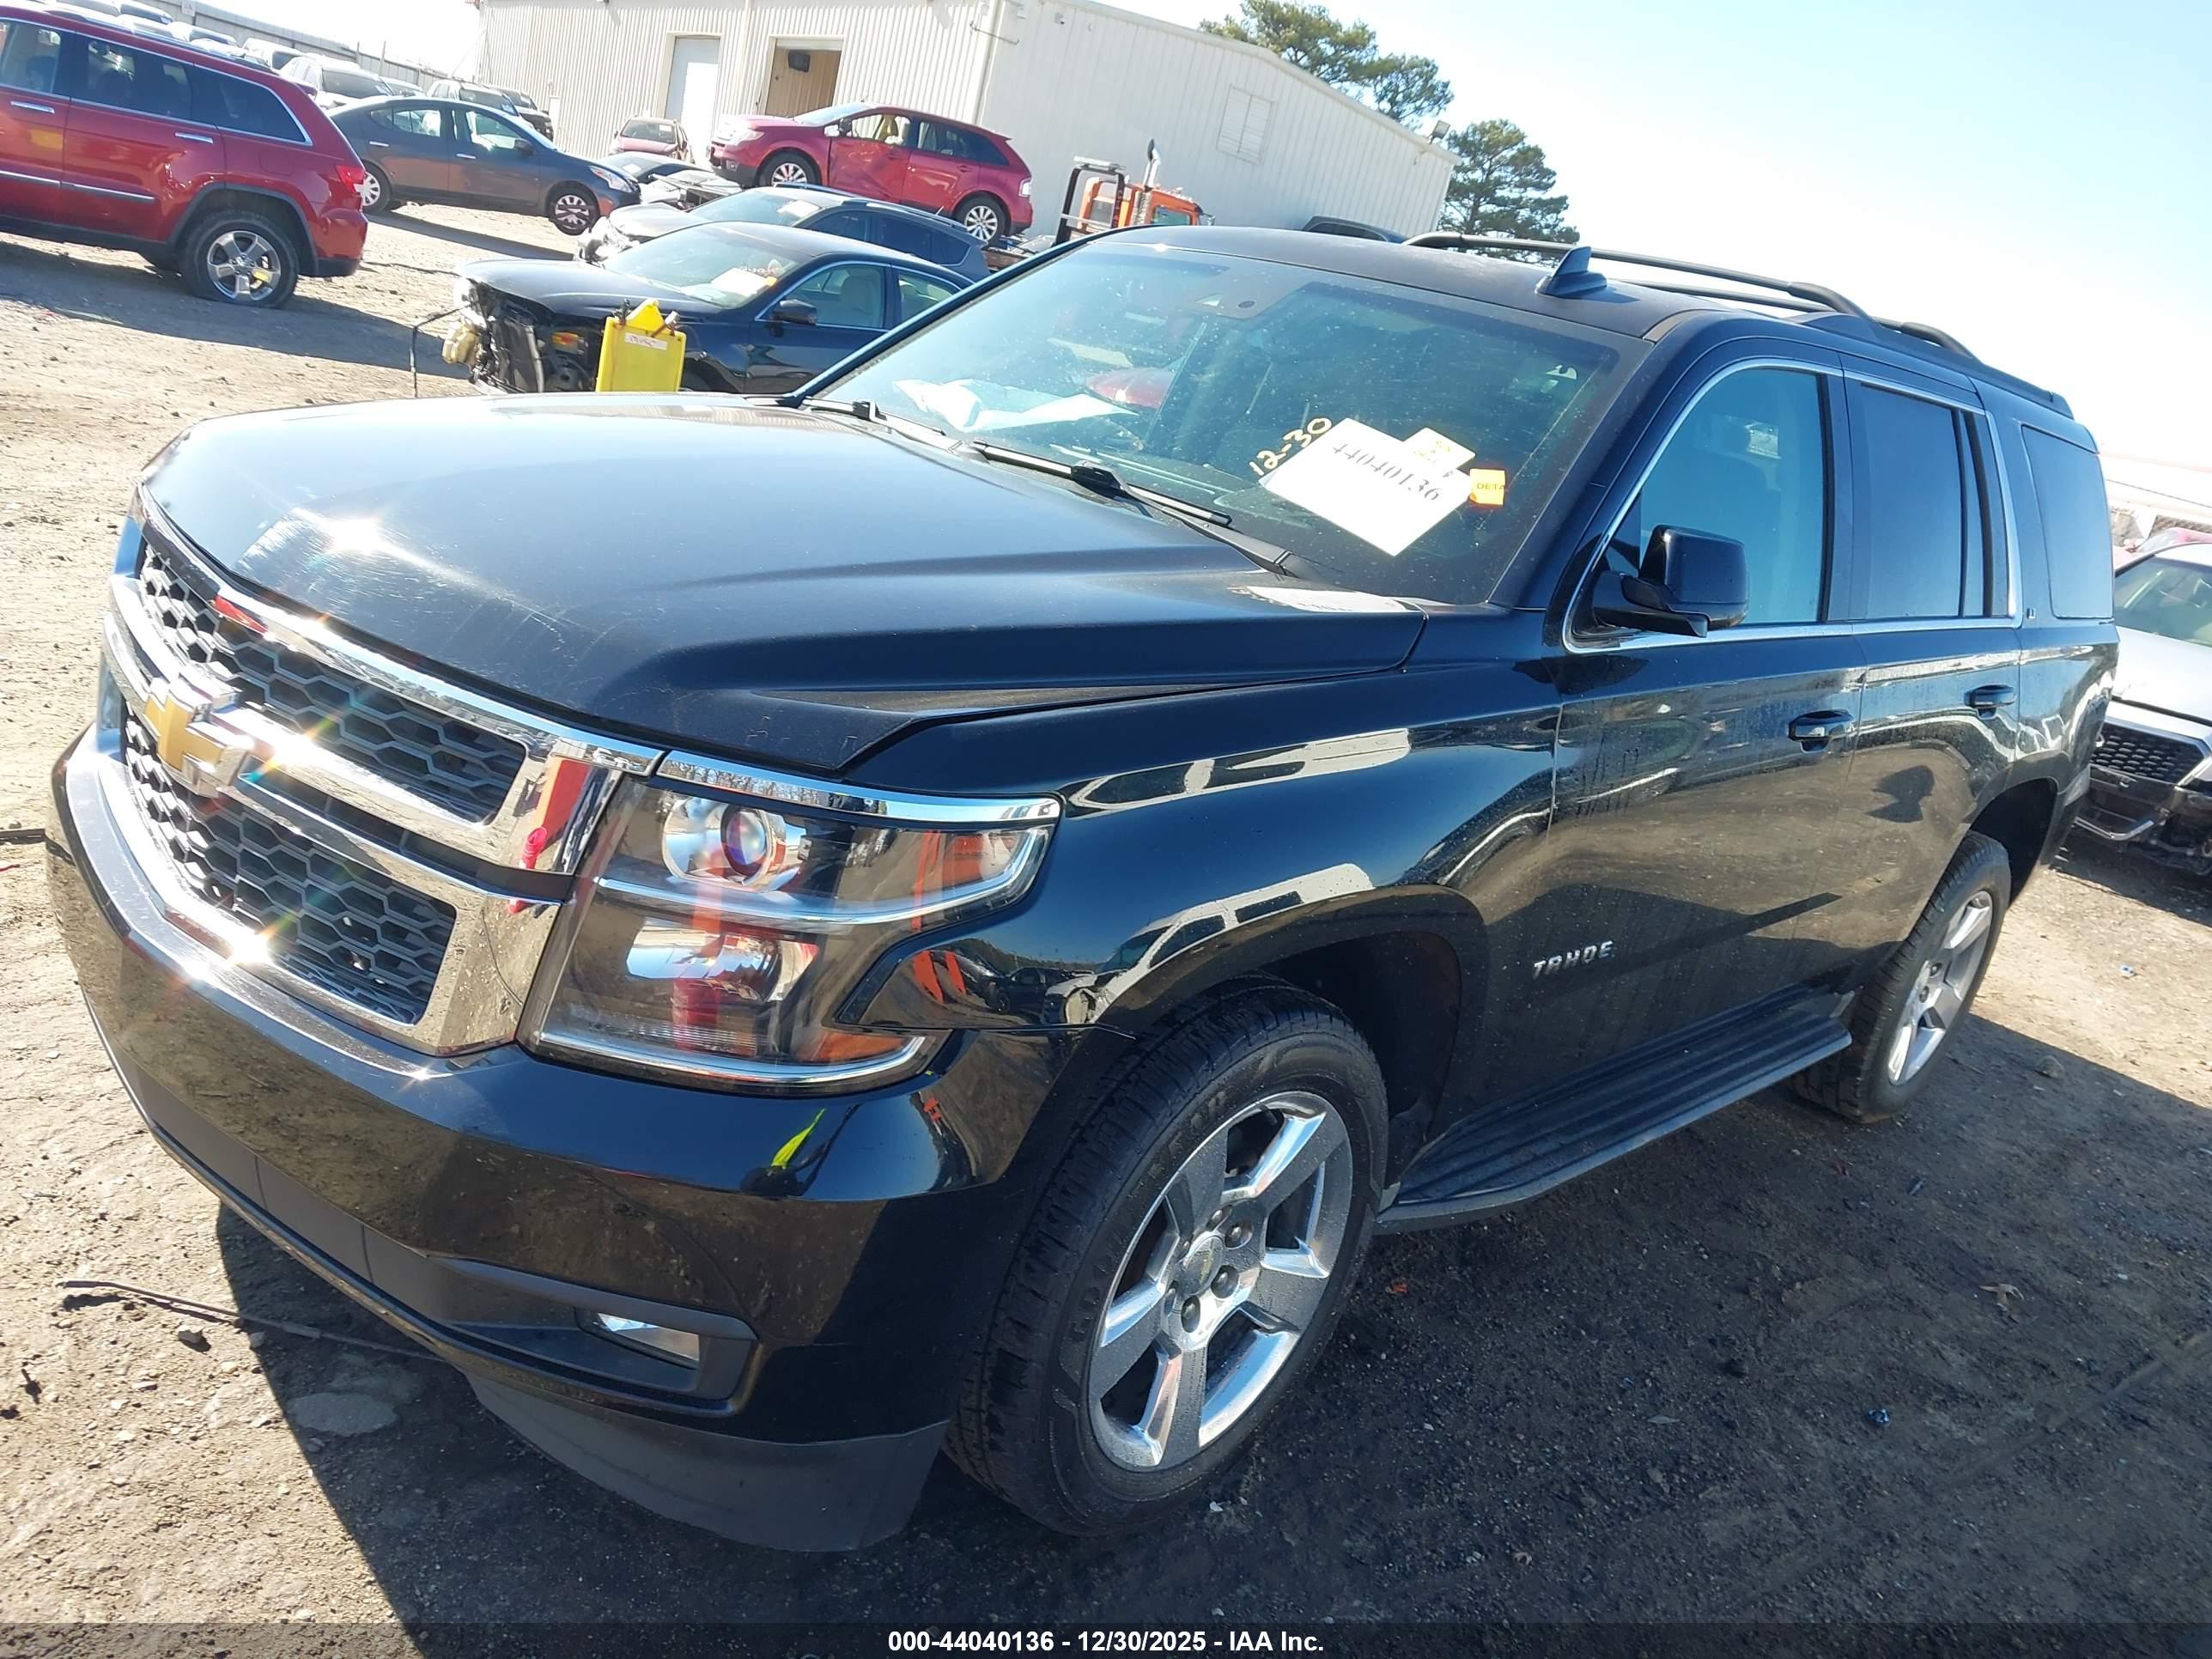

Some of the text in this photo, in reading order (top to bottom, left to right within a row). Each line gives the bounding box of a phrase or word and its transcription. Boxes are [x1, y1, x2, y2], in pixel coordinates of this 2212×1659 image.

[1249, 417, 1333, 476] 12-30
[1332, 441, 1442, 501] 44040136
[1533, 940, 1614, 980] TAHOE
